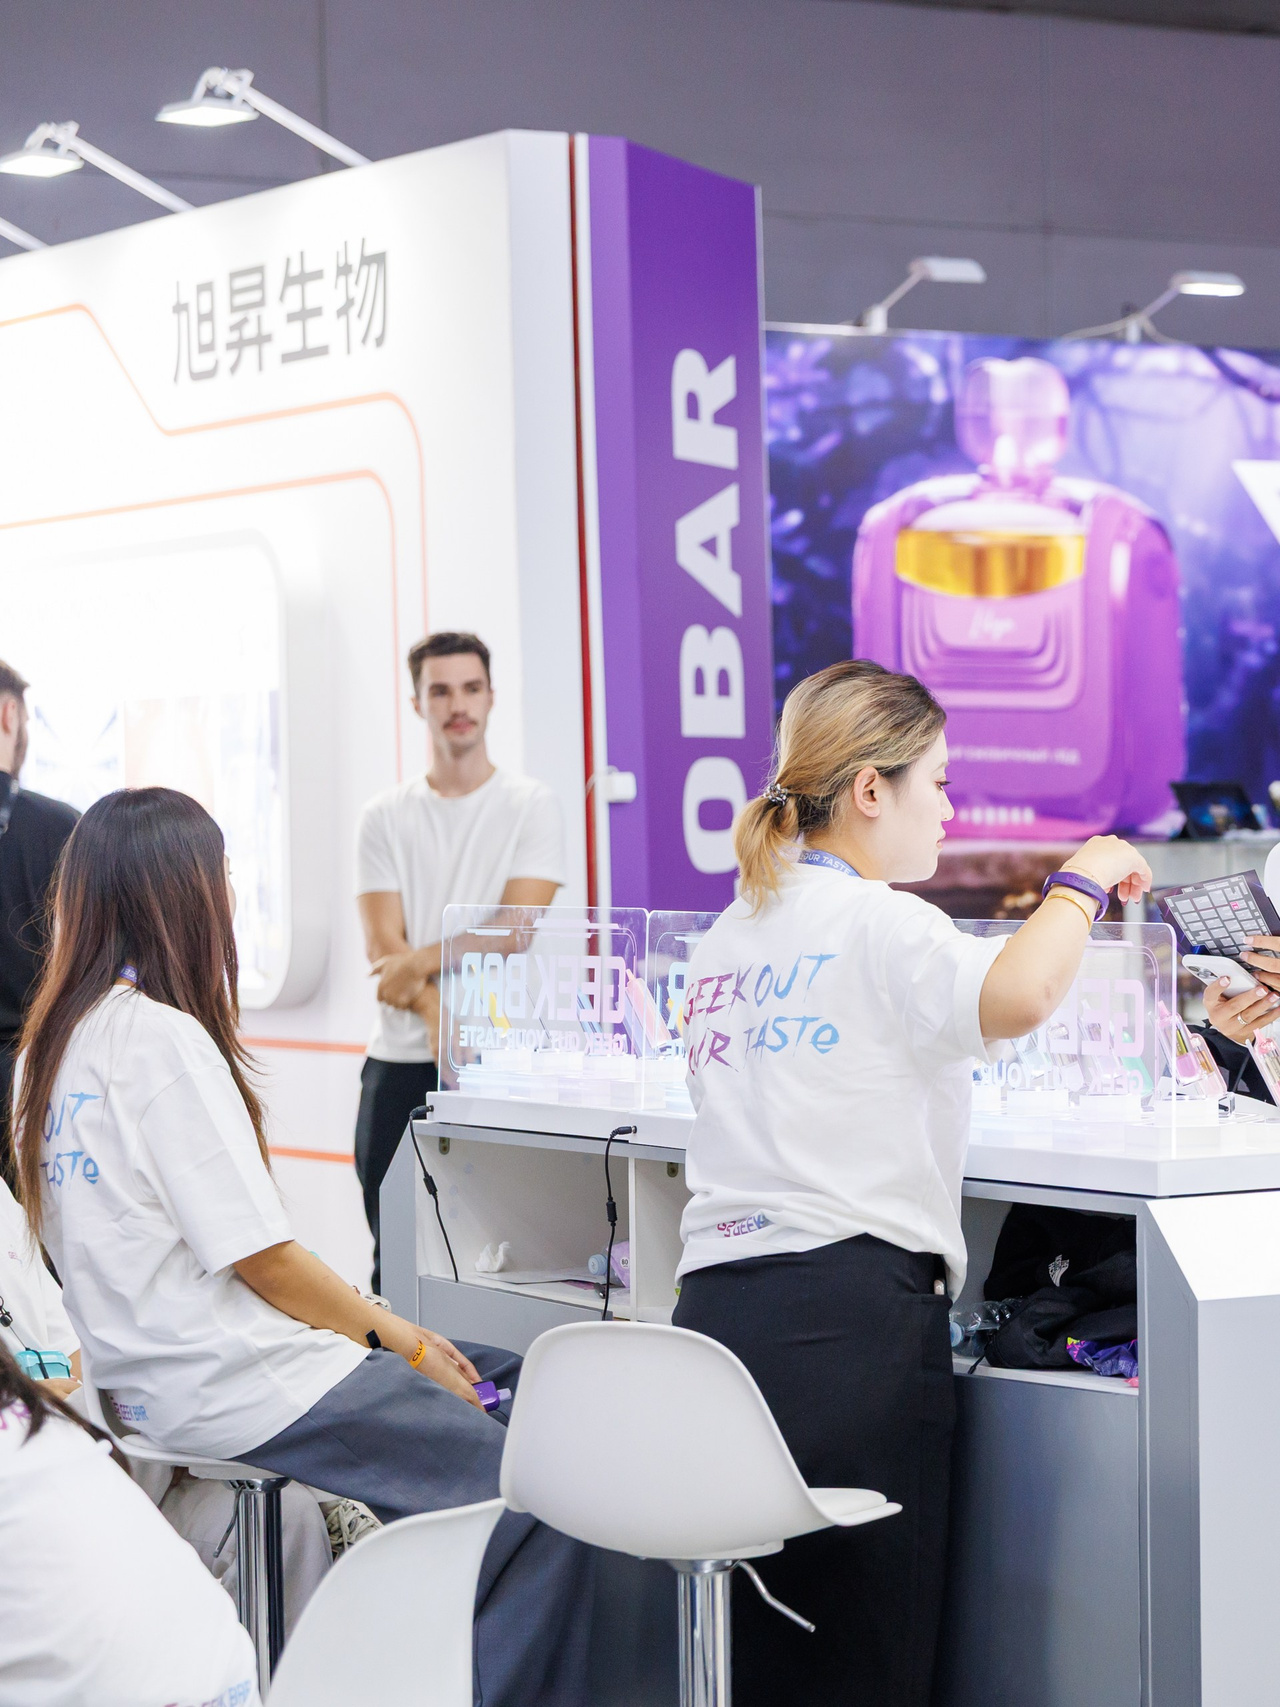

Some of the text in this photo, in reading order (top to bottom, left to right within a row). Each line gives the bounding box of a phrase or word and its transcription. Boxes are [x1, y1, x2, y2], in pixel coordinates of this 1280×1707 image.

[171, 236, 389, 386] 旭昇生物
[822, 856, 852, 874] TASTE
[754, 951, 841, 1007] OUT
